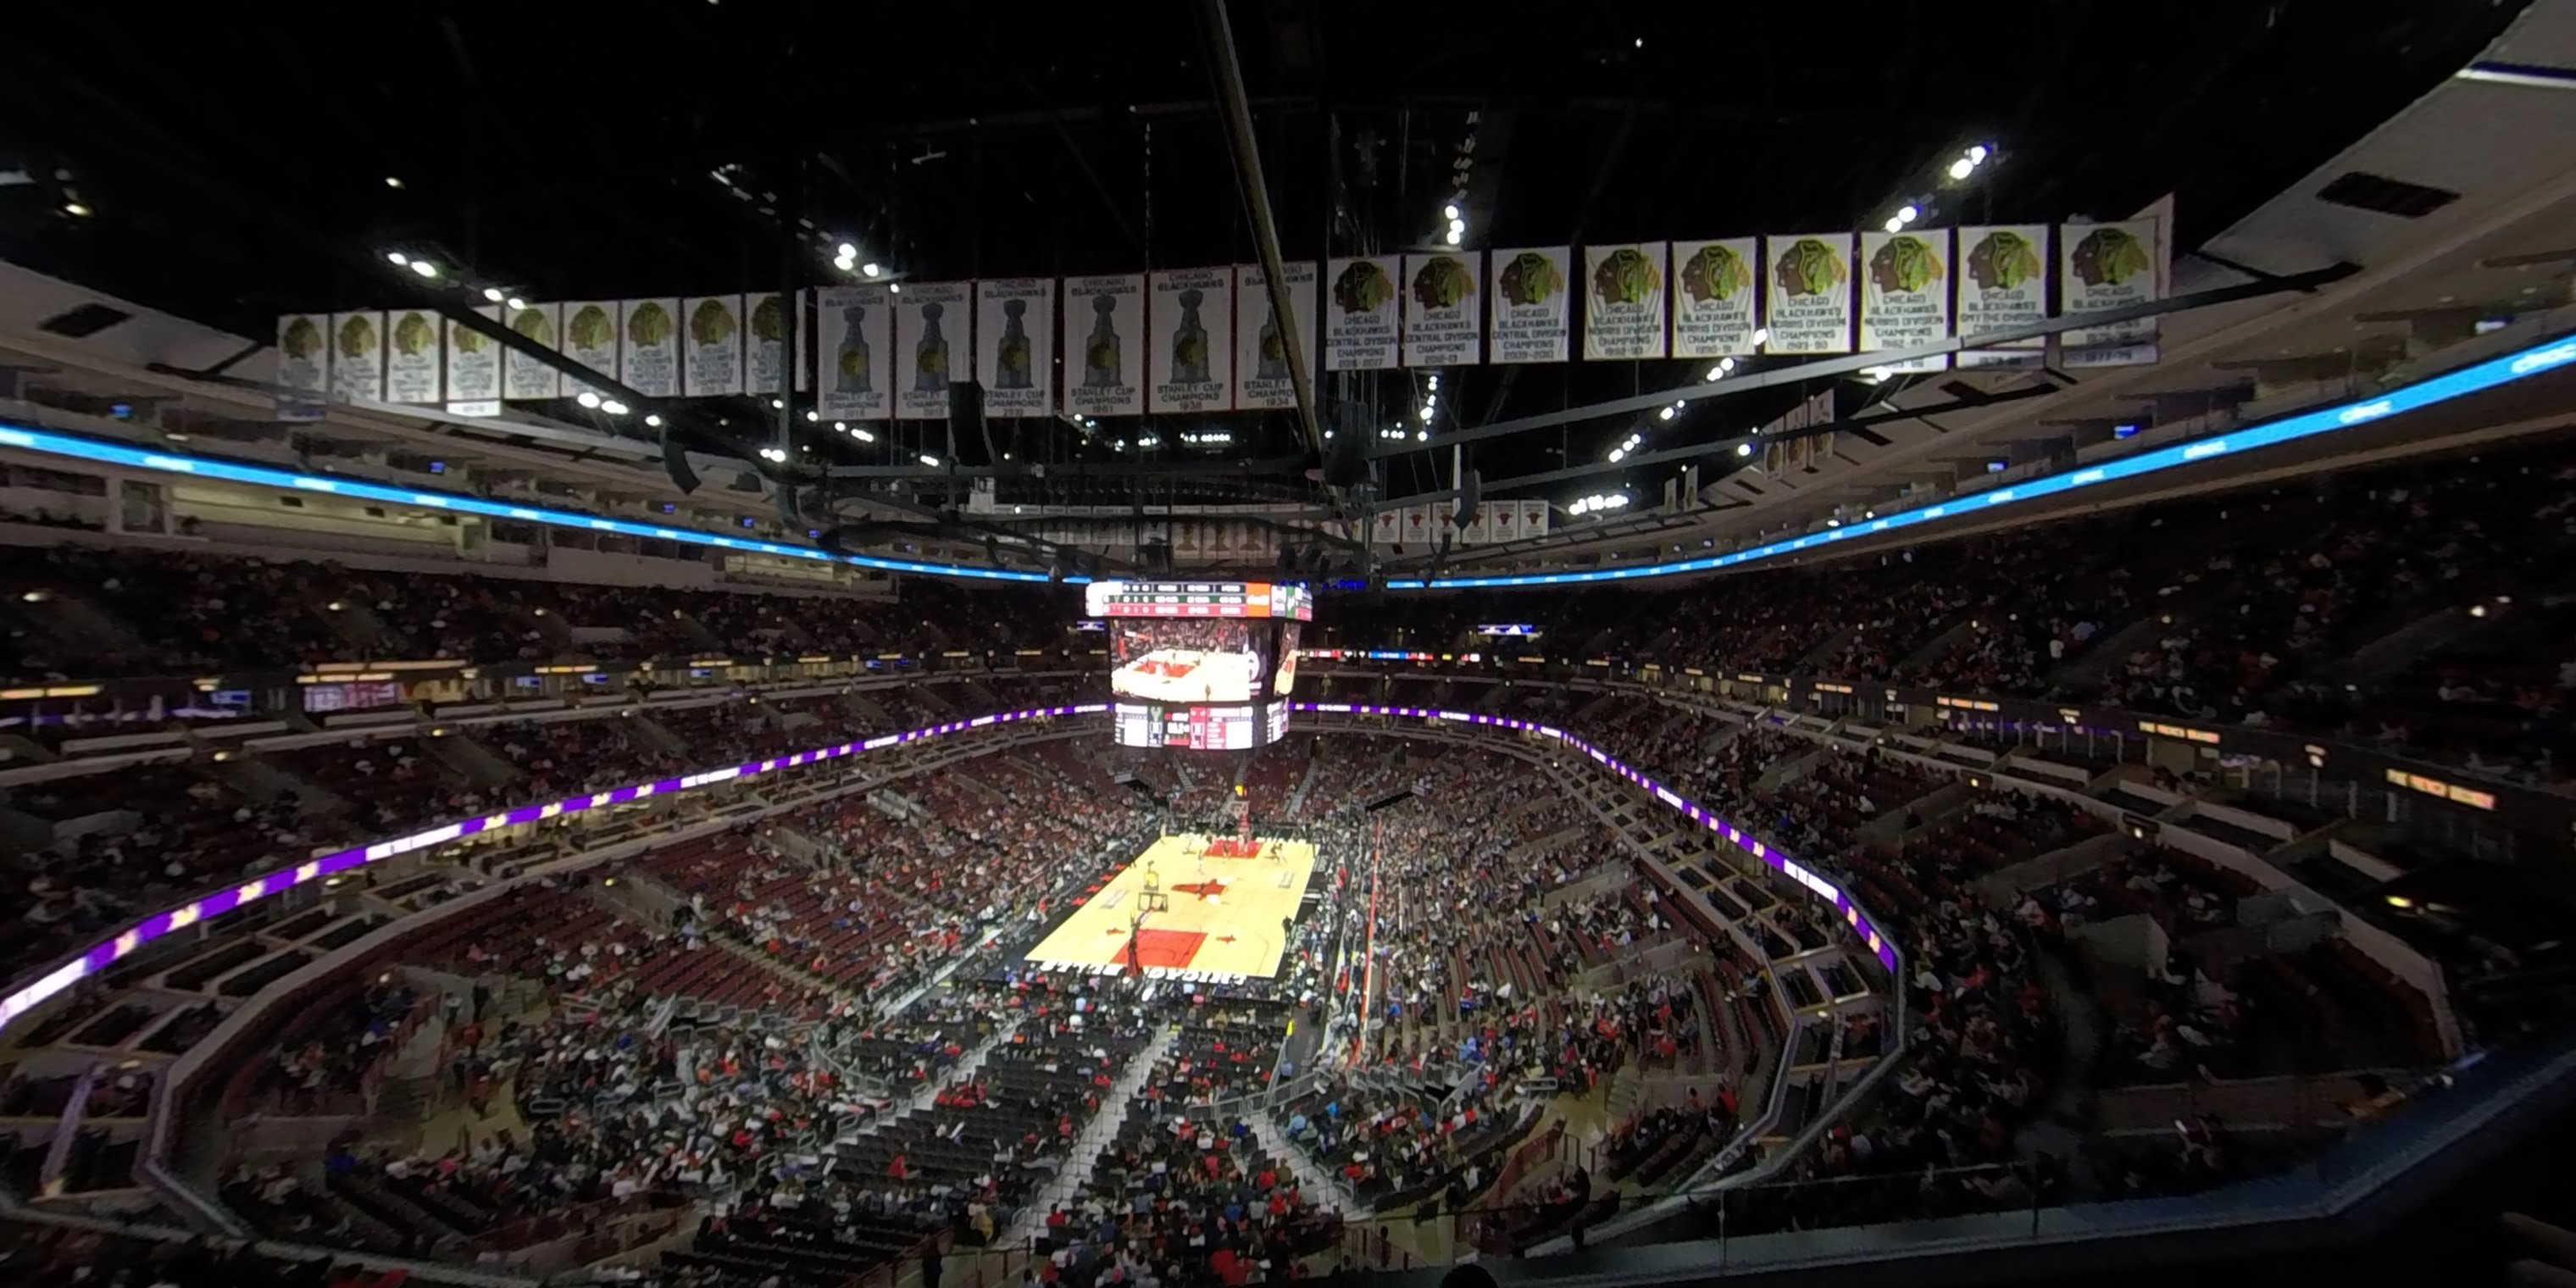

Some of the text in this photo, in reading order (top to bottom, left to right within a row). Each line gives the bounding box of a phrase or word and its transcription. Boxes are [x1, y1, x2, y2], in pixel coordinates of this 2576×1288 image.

[1158, 279, 1224, 292] BLACKHAWKS
[1883, 295, 1926, 304] CHICAGO
[1980, 291, 2024, 301] CHICAGO
[1788, 297, 1829, 307] CHICAGO
[1968, 302, 2036, 311] BLACKHAWKS
[1605, 304, 1644, 314] CHICAGO
[1694, 303, 1734, 312] CHICAGO
[1776, 307, 1841, 317] BLACKHAWKS
[1871, 304, 1937, 315] BLACKHAWKS
[1424, 310, 1461, 320] CHICAGO
[1510, 308, 1550, 318] CHICAGO
[1683, 312, 1746, 322] BLACKHAWKS
[1344, 315, 1380, 325] CHICAGO
[1498, 319, 1559, 329] BLACKHAWKS
[1594, 314, 1655, 325] BLACKHAWKS
[1333, 325, 1390, 336] BLACKHAWKS
[1412, 320, 1471, 332] BLACKHAWKS
[1406, 331, 1478, 343] CENTRAL DIVISION
[1492, 329, 1567, 339] CENTRAL DIVISION
[1780, 330, 1835, 340] CHAMPIONS
[1875, 327, 1932, 337] CHAMPIONS
[1327, 337, 1396, 347] CENTRAL DIVISION
[1598, 336, 1650, 346] CHAMPIONS
[1687, 334, 1740, 344] CHAMPIONS
[1416, 343, 1466, 353] CHAMPIONS
[1502, 340, 1555, 350] CHAMPIONS
[1336, 347, 1385, 358] CHAMPIONS
[1157, 383, 1223, 394] STANLEY CUP
[1244, 380, 1286, 390] STANLEY
[902, 391, 941, 401] STANLEY
[1026, 390, 1045, 398] CUP
[1071, 386, 1135, 397] STANLEY CUP
[1247, 389, 1294, 398] CHAMPIO
[1074, 396, 1131, 405] CHAMPIONS
[1161, 392, 1220, 402] CHAMPIONS
[906, 399, 949, 408] CHAMPIO
[987, 399, 1043, 408] CHAMPIONS
[1266, 398, 1290, 407] 1934
